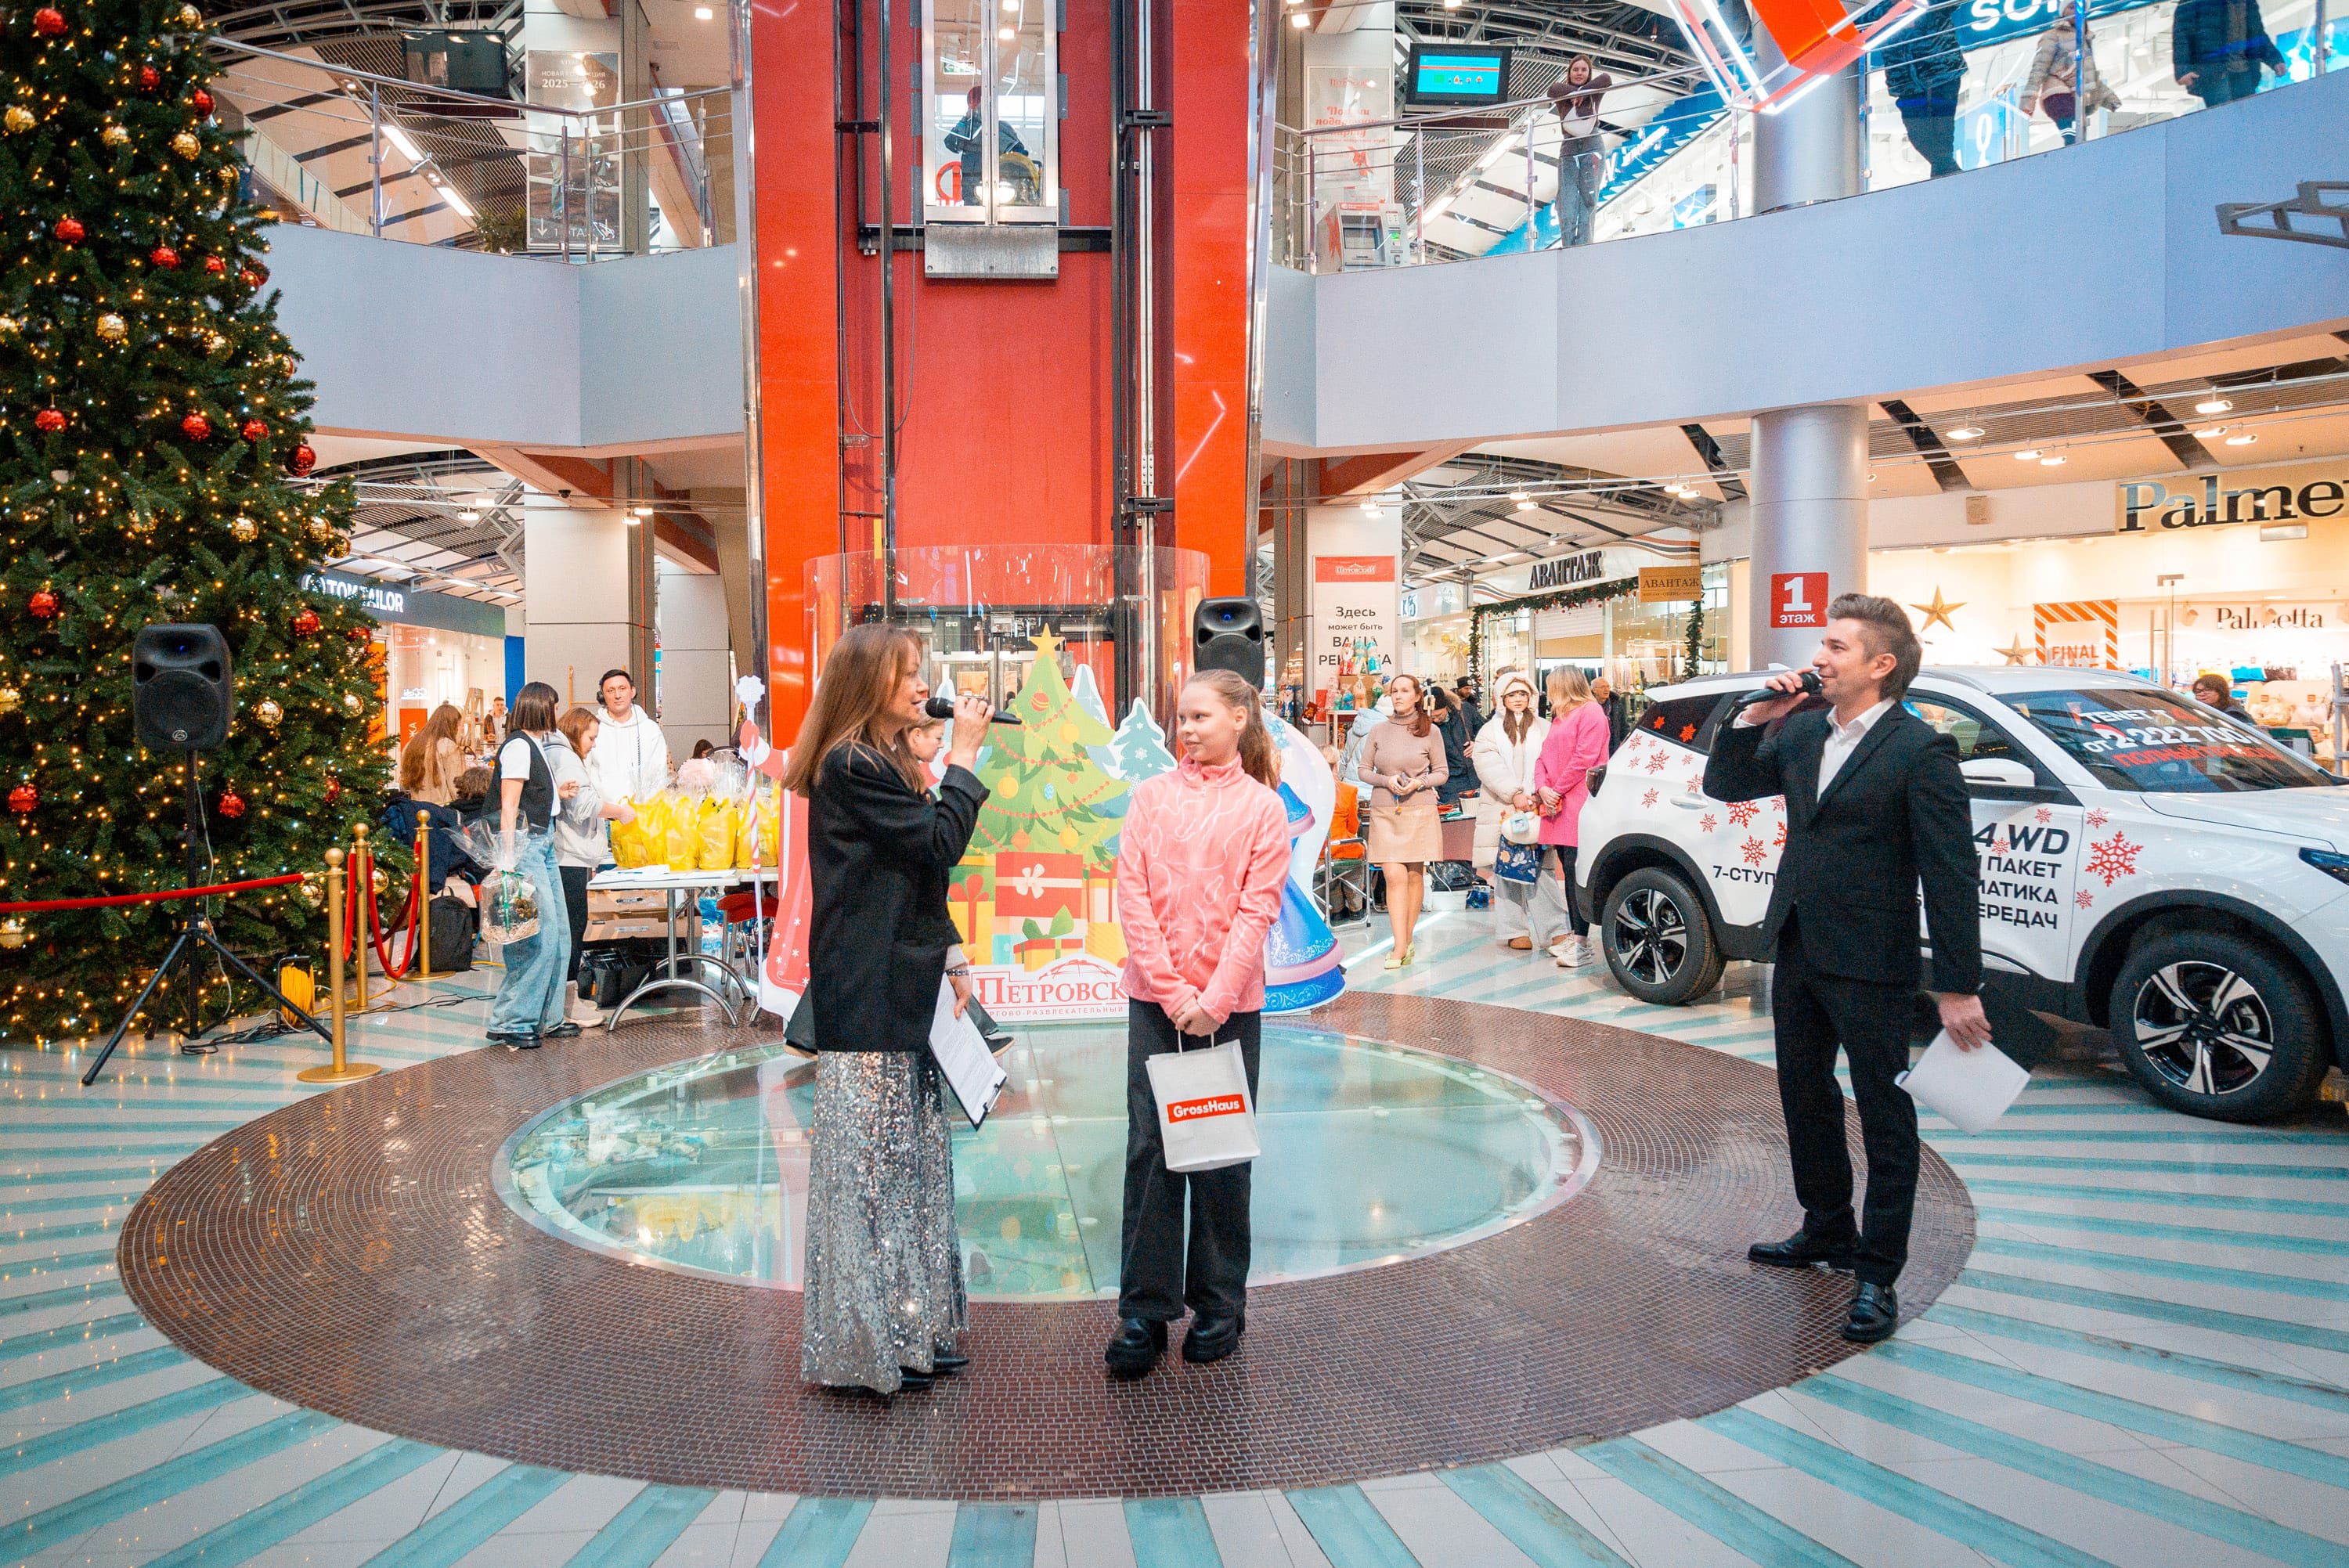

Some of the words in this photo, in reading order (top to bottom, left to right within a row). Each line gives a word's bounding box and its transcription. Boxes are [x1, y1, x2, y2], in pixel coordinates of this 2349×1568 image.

[2119, 474, 2349, 532] Palme
[1528, 550, 1606, 591] АВАНТАЖ
[1644, 578, 1699, 588] АВАНТАЖ
[1783, 576, 1812, 611] 1
[1336, 606, 1376, 618] Здесь
[1779, 614, 1816, 624] этаж
[2216, 607, 2322, 629] Paletta
[2051, 645, 2099, 660] FINAL
[2078, 709, 2154, 723] TENET
[2111, 744, 2206, 767] ПОЛНЫЙ
[1987, 856, 2062, 878] ПАКЕТ
[1173, 1100, 1239, 1118] GrossHaus
